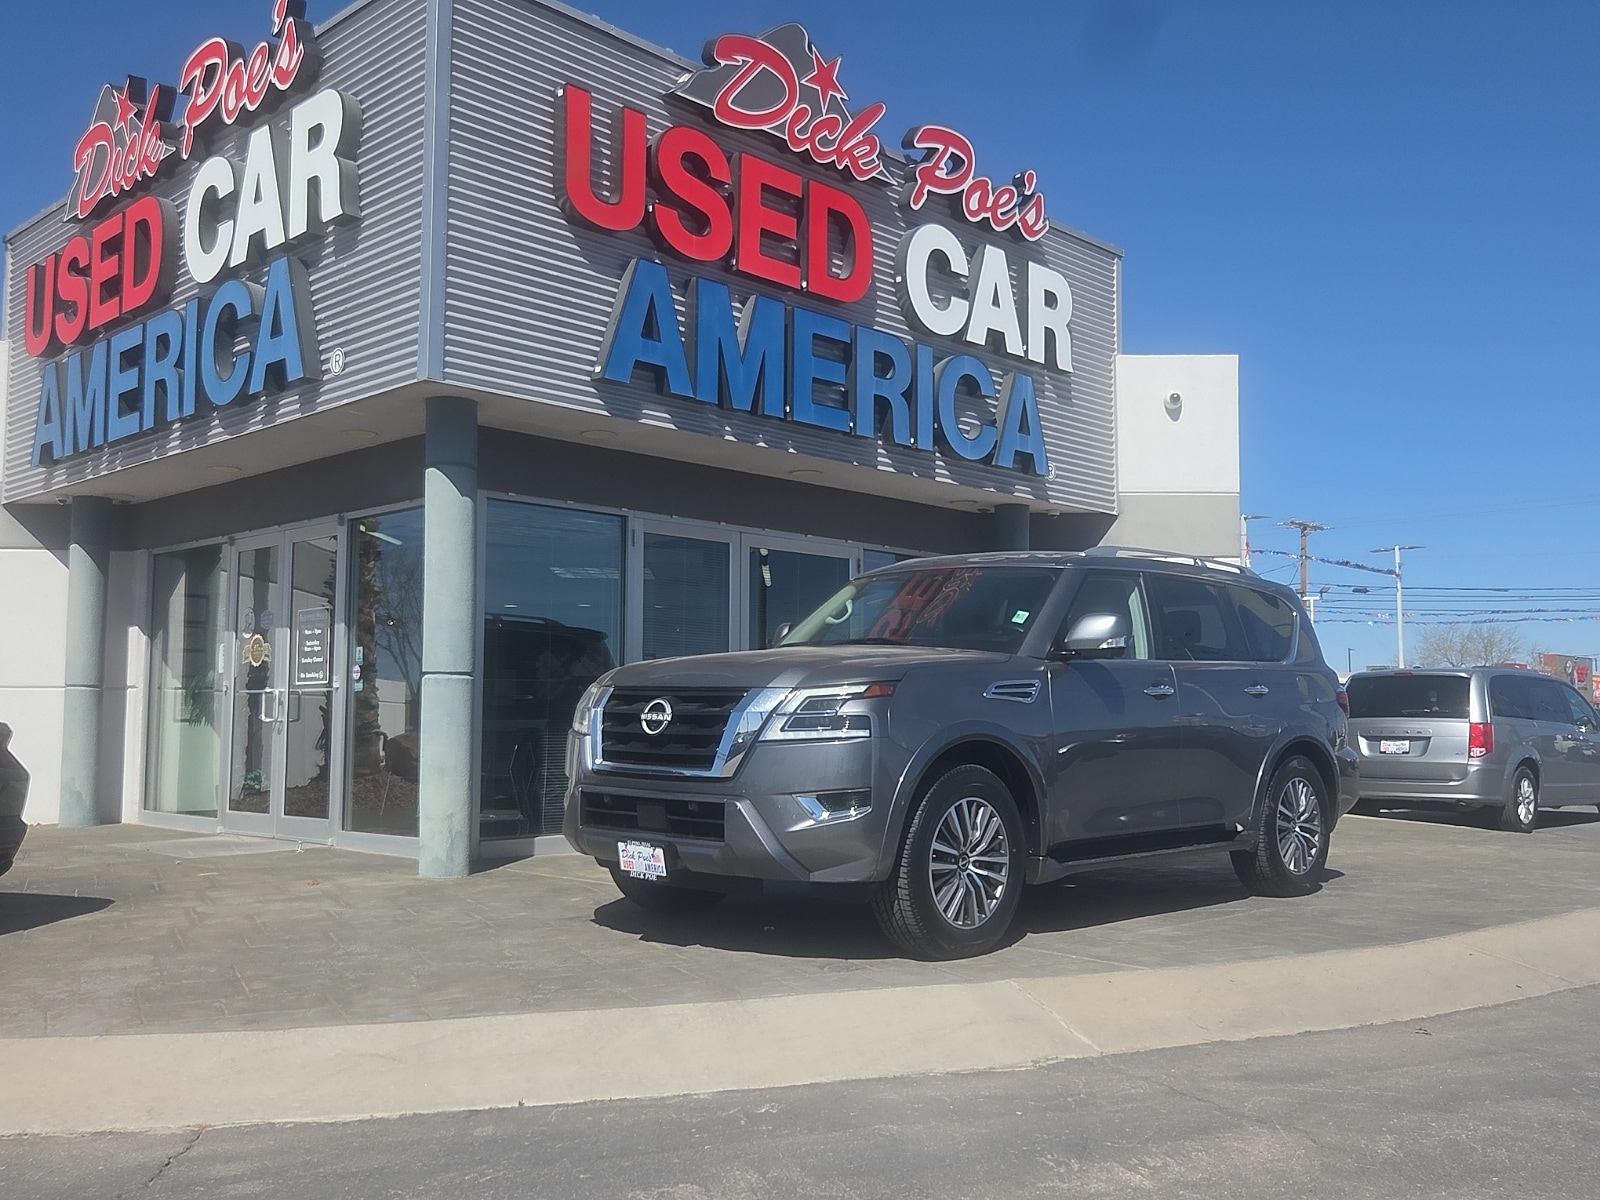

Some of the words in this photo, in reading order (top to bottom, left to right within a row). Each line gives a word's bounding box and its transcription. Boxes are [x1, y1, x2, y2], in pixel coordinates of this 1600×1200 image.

[74, 83, 165, 219] Dick
[180, 0, 304, 160] Poe's
[713, 33, 886, 180] Dick
[909, 125, 1050, 242] Poe's
[25, 196, 163, 357] USED
[185, 89, 345, 283] CAR
[565, 83, 873, 302] USED
[905, 224, 1073, 373] CAR
[31, 257, 304, 467] AMERICA
[603, 258, 1050, 477] AMERICA
[640, 712, 672, 722] NISSAN
[630, 871, 644, 879] DICK
[645, 863, 664, 874] AMERICA
